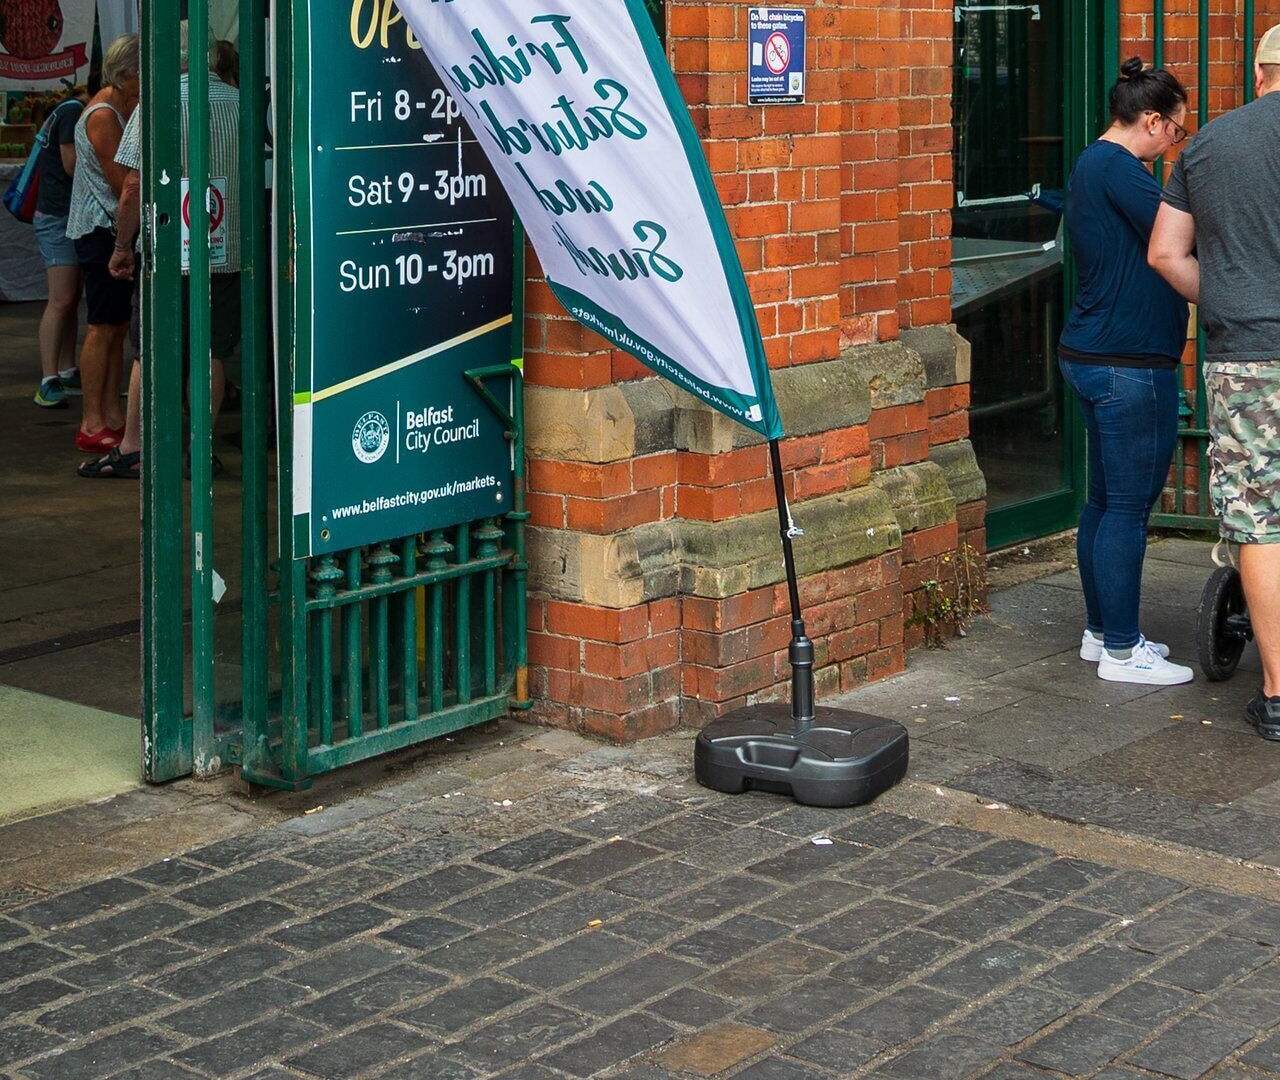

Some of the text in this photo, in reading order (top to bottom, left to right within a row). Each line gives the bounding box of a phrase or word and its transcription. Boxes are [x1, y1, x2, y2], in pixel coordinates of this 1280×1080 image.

[350, 91, 382, 123] Fri
[394, 88, 411, 121] 8
[430, 88, 464, 125] 2p
[348, 173, 392, 208] Sat
[397, 172, 415, 204] 9
[434, 170, 486, 205] 3pm
[339, 259, 390, 293] Sun
[395, 253, 423, 284] 10
[442, 249, 495, 285] 3pm
[405, 426, 433, 453] City
[434, 417, 480, 444] Council
[406, 404, 454, 430] Belfast
[332, 473, 496, 521] www.belfastcity.gov.uk/markets
